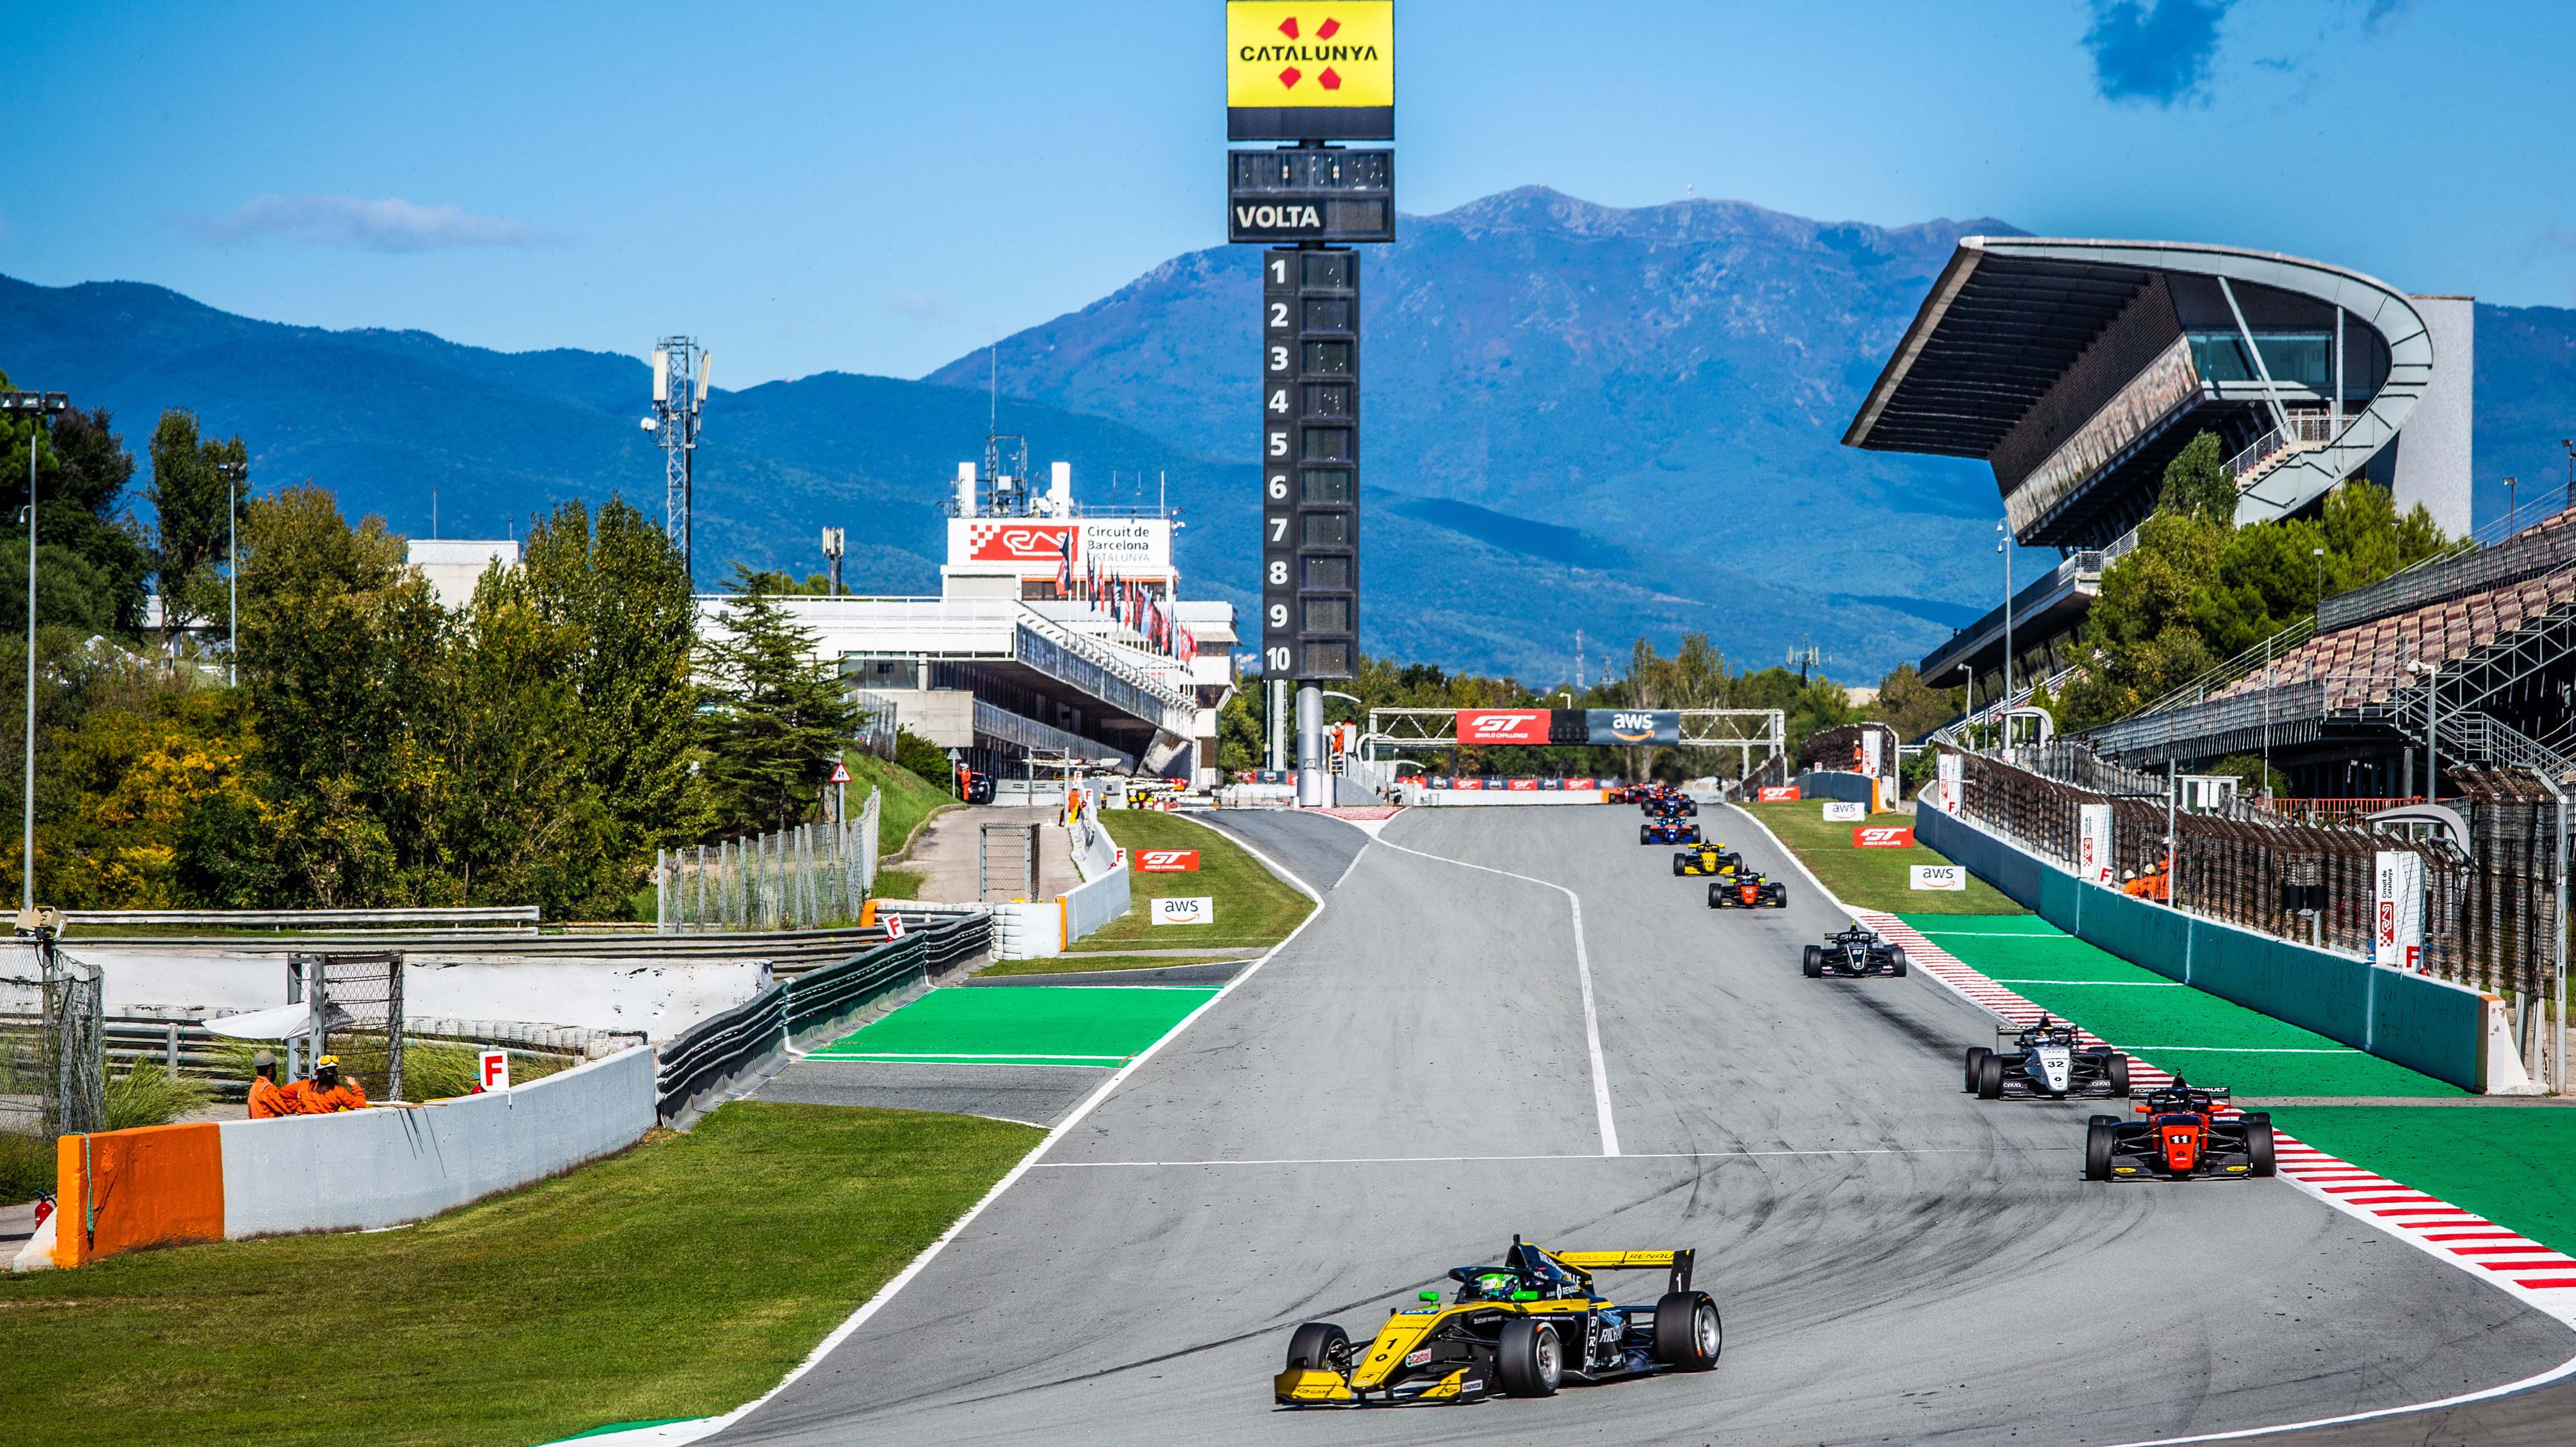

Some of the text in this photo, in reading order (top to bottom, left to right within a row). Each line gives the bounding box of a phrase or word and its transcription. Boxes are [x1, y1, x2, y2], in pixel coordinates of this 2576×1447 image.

[1240, 46, 1378, 61] CATALUNYA
[1236, 205, 1320, 228] VOLTA
[1271, 259, 1286, 283] 1
[1270, 302, 1288, 327] 2
[1270, 346, 1288, 371] 3
[1269, 389, 1289, 413] 4
[1270, 432, 1287, 456] 5
[1269, 475, 1287, 499] 6
[1088, 526, 1149, 537] Circuit de
[1270, 518, 1287, 542] 7
[1088, 540, 1149, 550] Barcelona
[1270, 561, 1288, 585] 8
[1270, 604, 1288, 628] 9
[1266, 646, 1290, 671] 10
[1471, 715, 1538, 731] GT
[1613, 713, 1654, 730] aws
[1086, 790, 1092, 799] F
[1833, 803, 1856, 812] aws
[1949, 802, 1955, 812] F
[1860, 828, 1907, 841] GT
[1117, 850, 1124, 862] F
[1142, 851, 1192, 864] GT
[1923, 868, 1953, 879] aws
[2100, 867, 2111, 881] F
[1165, 900, 1198, 912] aws
[888, 916, 900, 936] F
[2406, 946, 2420, 968] F
[485, 1055, 503, 1086] F
[2171, 1135, 2188, 1144] 11
[1676, 1273, 1681, 1292] 1
[1386, 1338, 1398, 1350] 1
